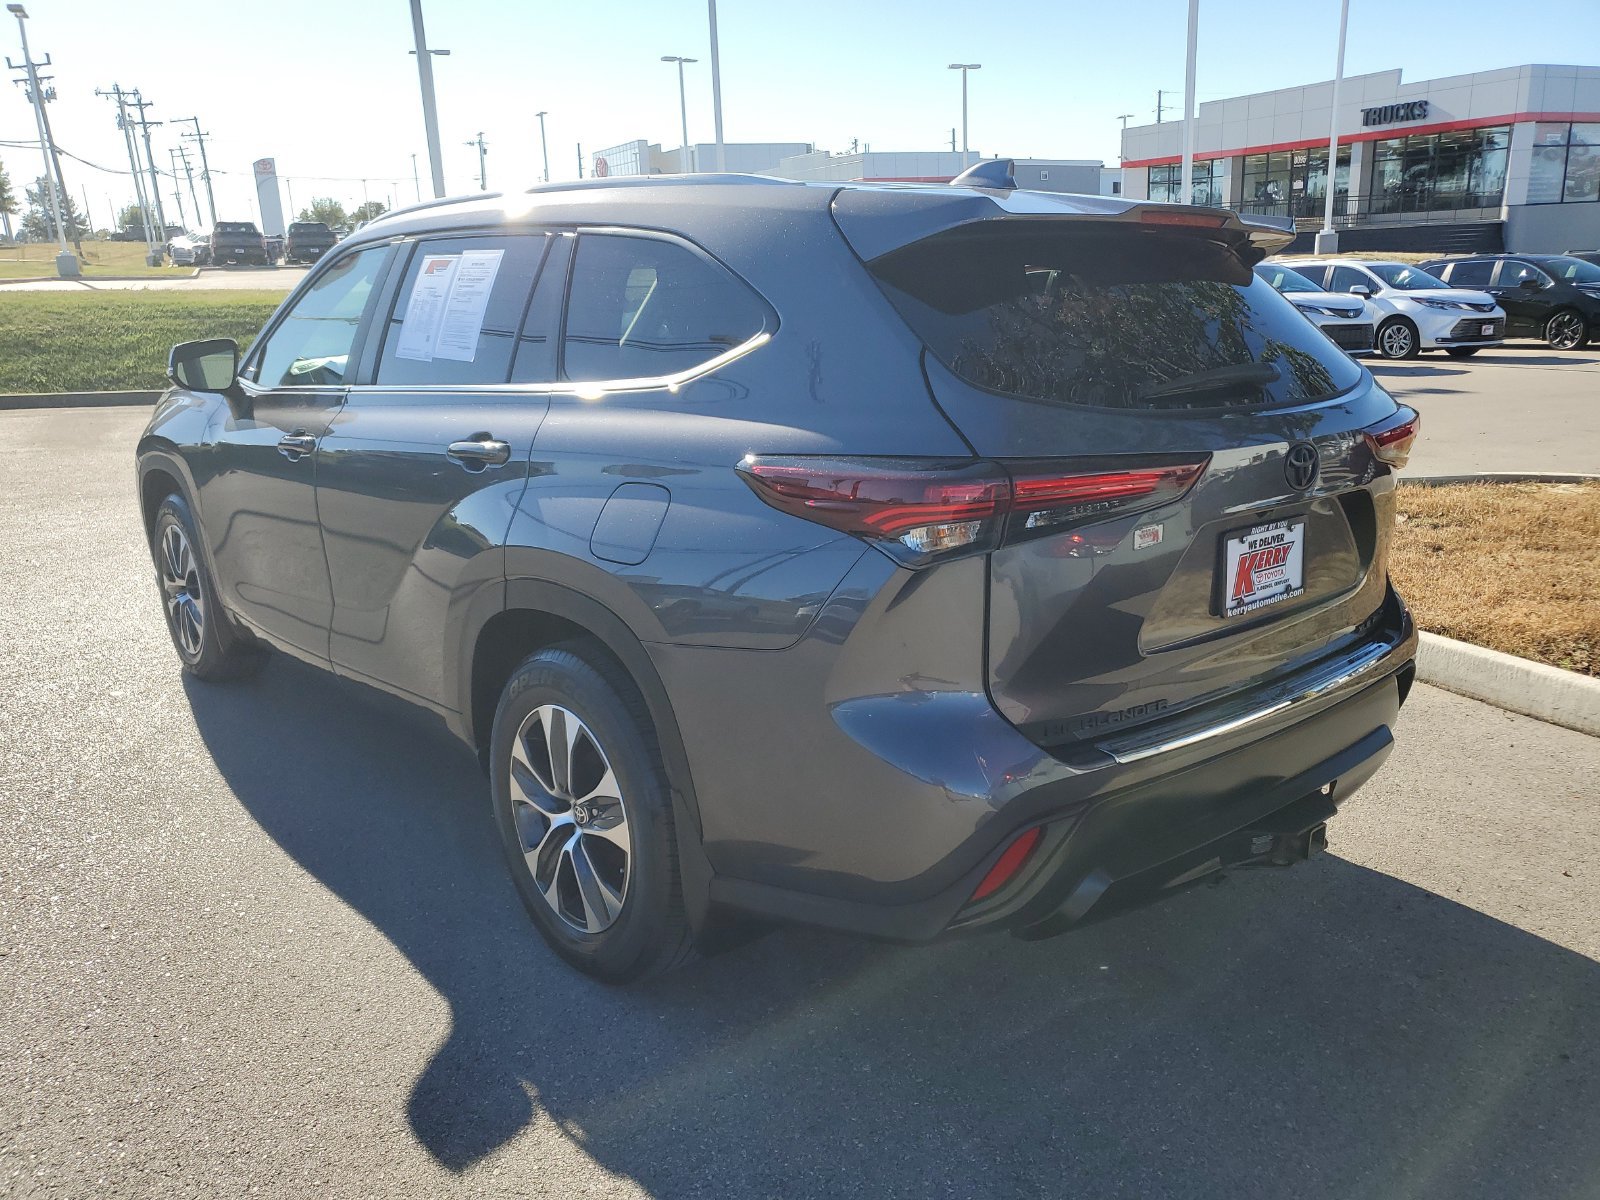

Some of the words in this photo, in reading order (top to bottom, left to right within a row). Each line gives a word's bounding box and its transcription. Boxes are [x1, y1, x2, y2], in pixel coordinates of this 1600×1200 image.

[1361, 100, 1429, 126] TRUCKS
[1250, 524, 1269, 535] RIGHT
[1268, 522, 1277, 531] BY
[1277, 520, 1288, 529] YOU
[1248, 539, 1258, 550] WE
[1258, 533, 1285, 548] DELIVER
[1233, 543, 1293, 601] KERRY
[1264, 569, 1284, 580] TOYOTA
[1227, 588, 1304, 617] kerryautomotive.com
[1043, 698, 1169, 738] HIHLANDER
